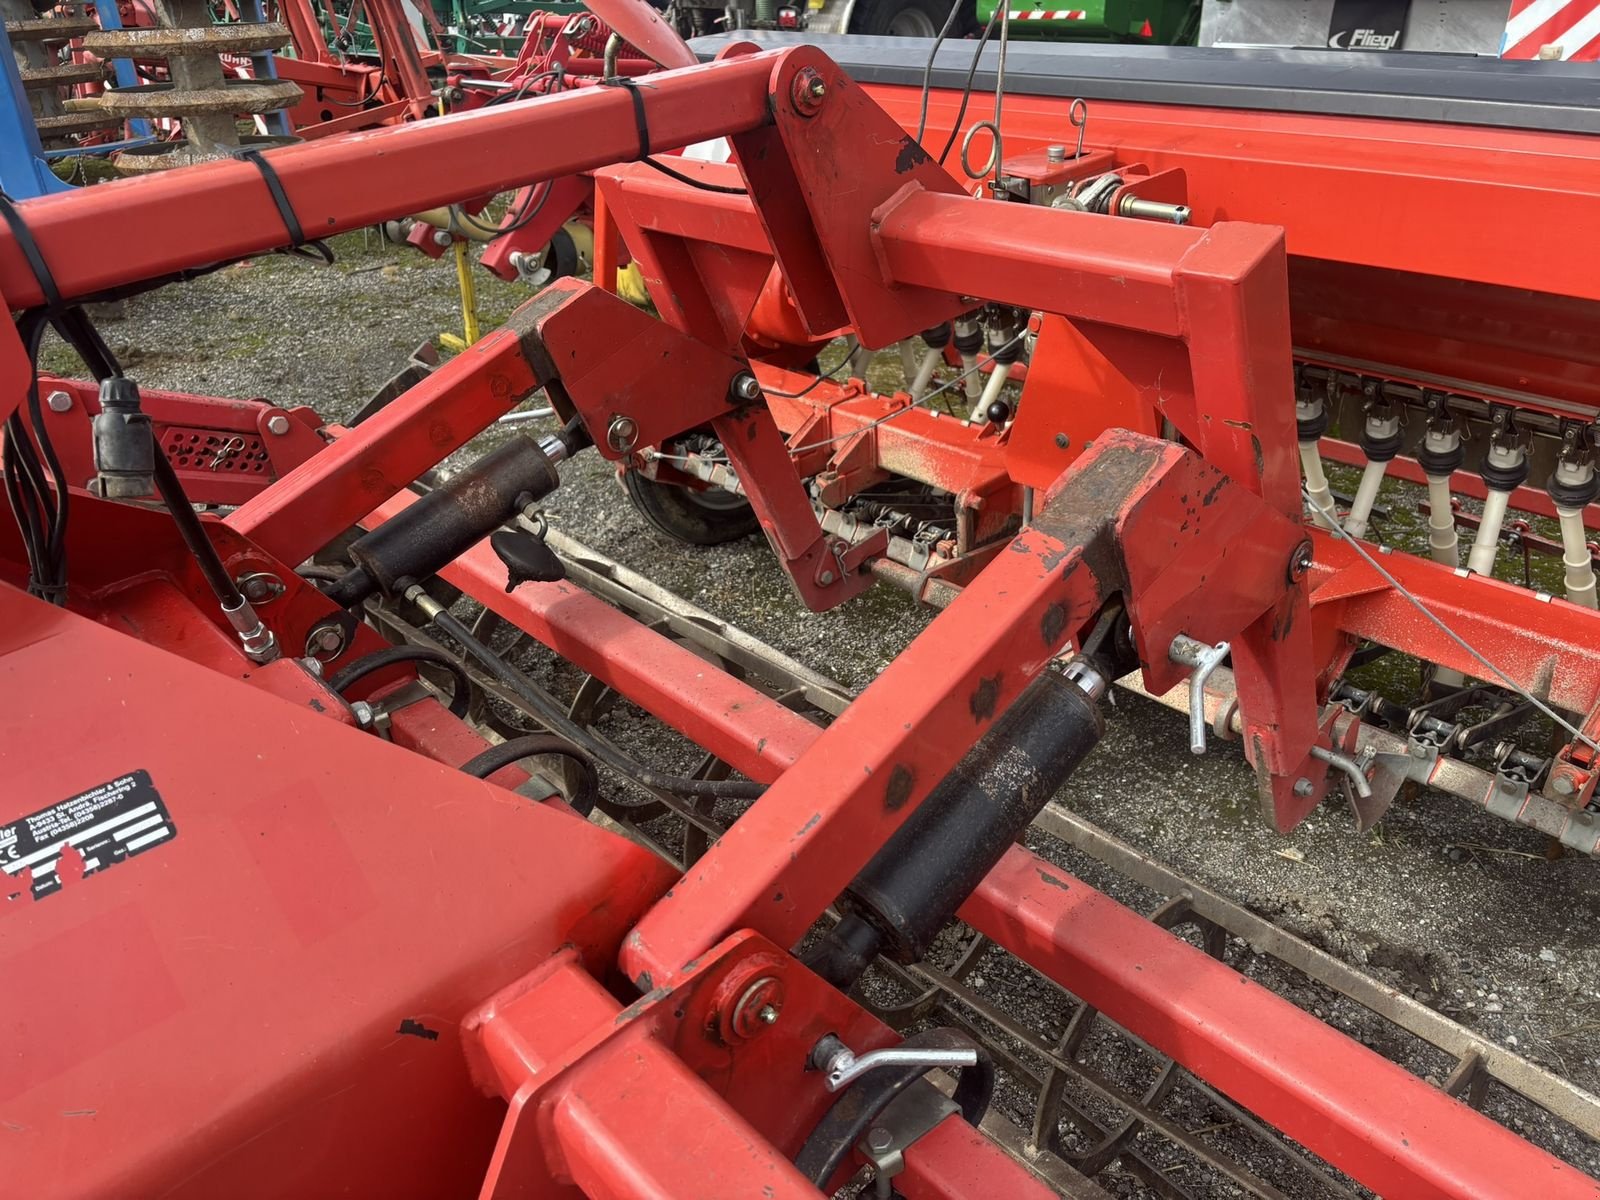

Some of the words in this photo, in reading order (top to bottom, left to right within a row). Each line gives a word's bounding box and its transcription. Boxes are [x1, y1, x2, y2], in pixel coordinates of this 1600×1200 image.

[1348, 29, 1400, 50] Fliegl
[26, 810, 56, 824] Thomas
[56, 787, 106, 812] Hatzenbichler
[113, 776, 134, 788] Sohn
[29, 815, 56, 831] A-9433
[92, 784, 131, 804] Fischering
[34, 833, 49, 843] Fax
